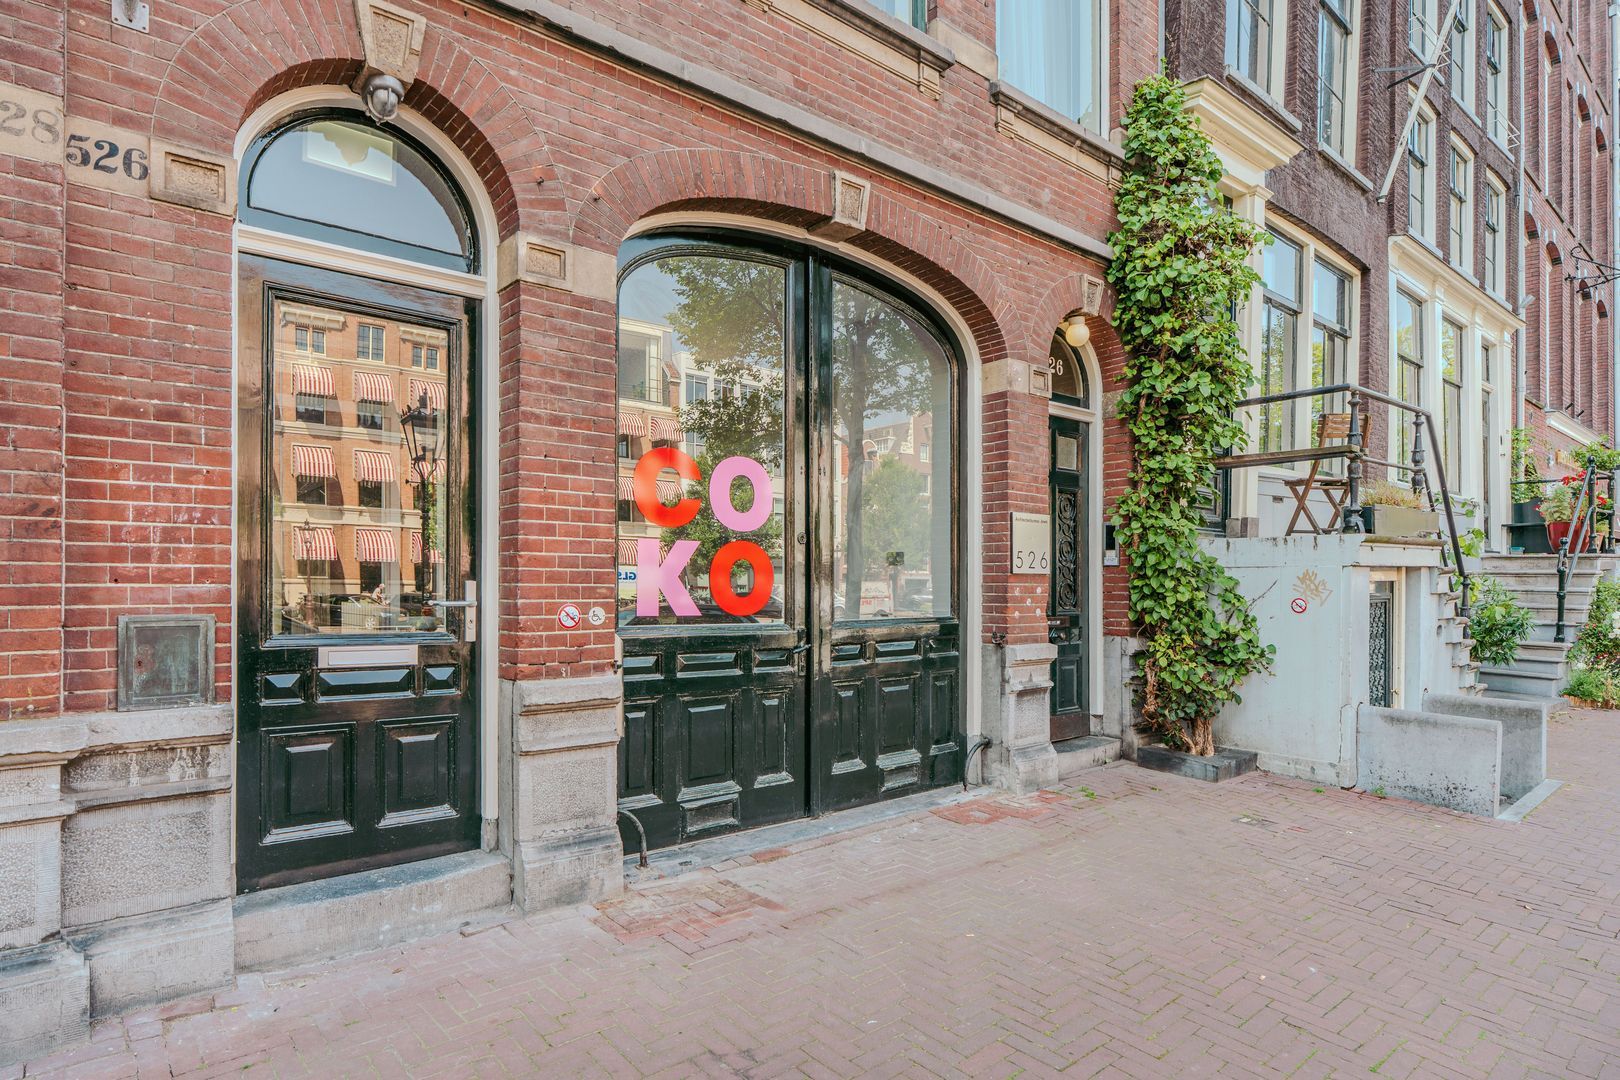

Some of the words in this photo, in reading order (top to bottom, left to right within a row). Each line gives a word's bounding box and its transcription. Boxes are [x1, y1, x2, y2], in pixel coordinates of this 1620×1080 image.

[66, 134, 149, 180] 526
[633, 447, 774, 532] CO
[636, 538, 775, 617] KO
[1015, 551, 1048, 569] 526
